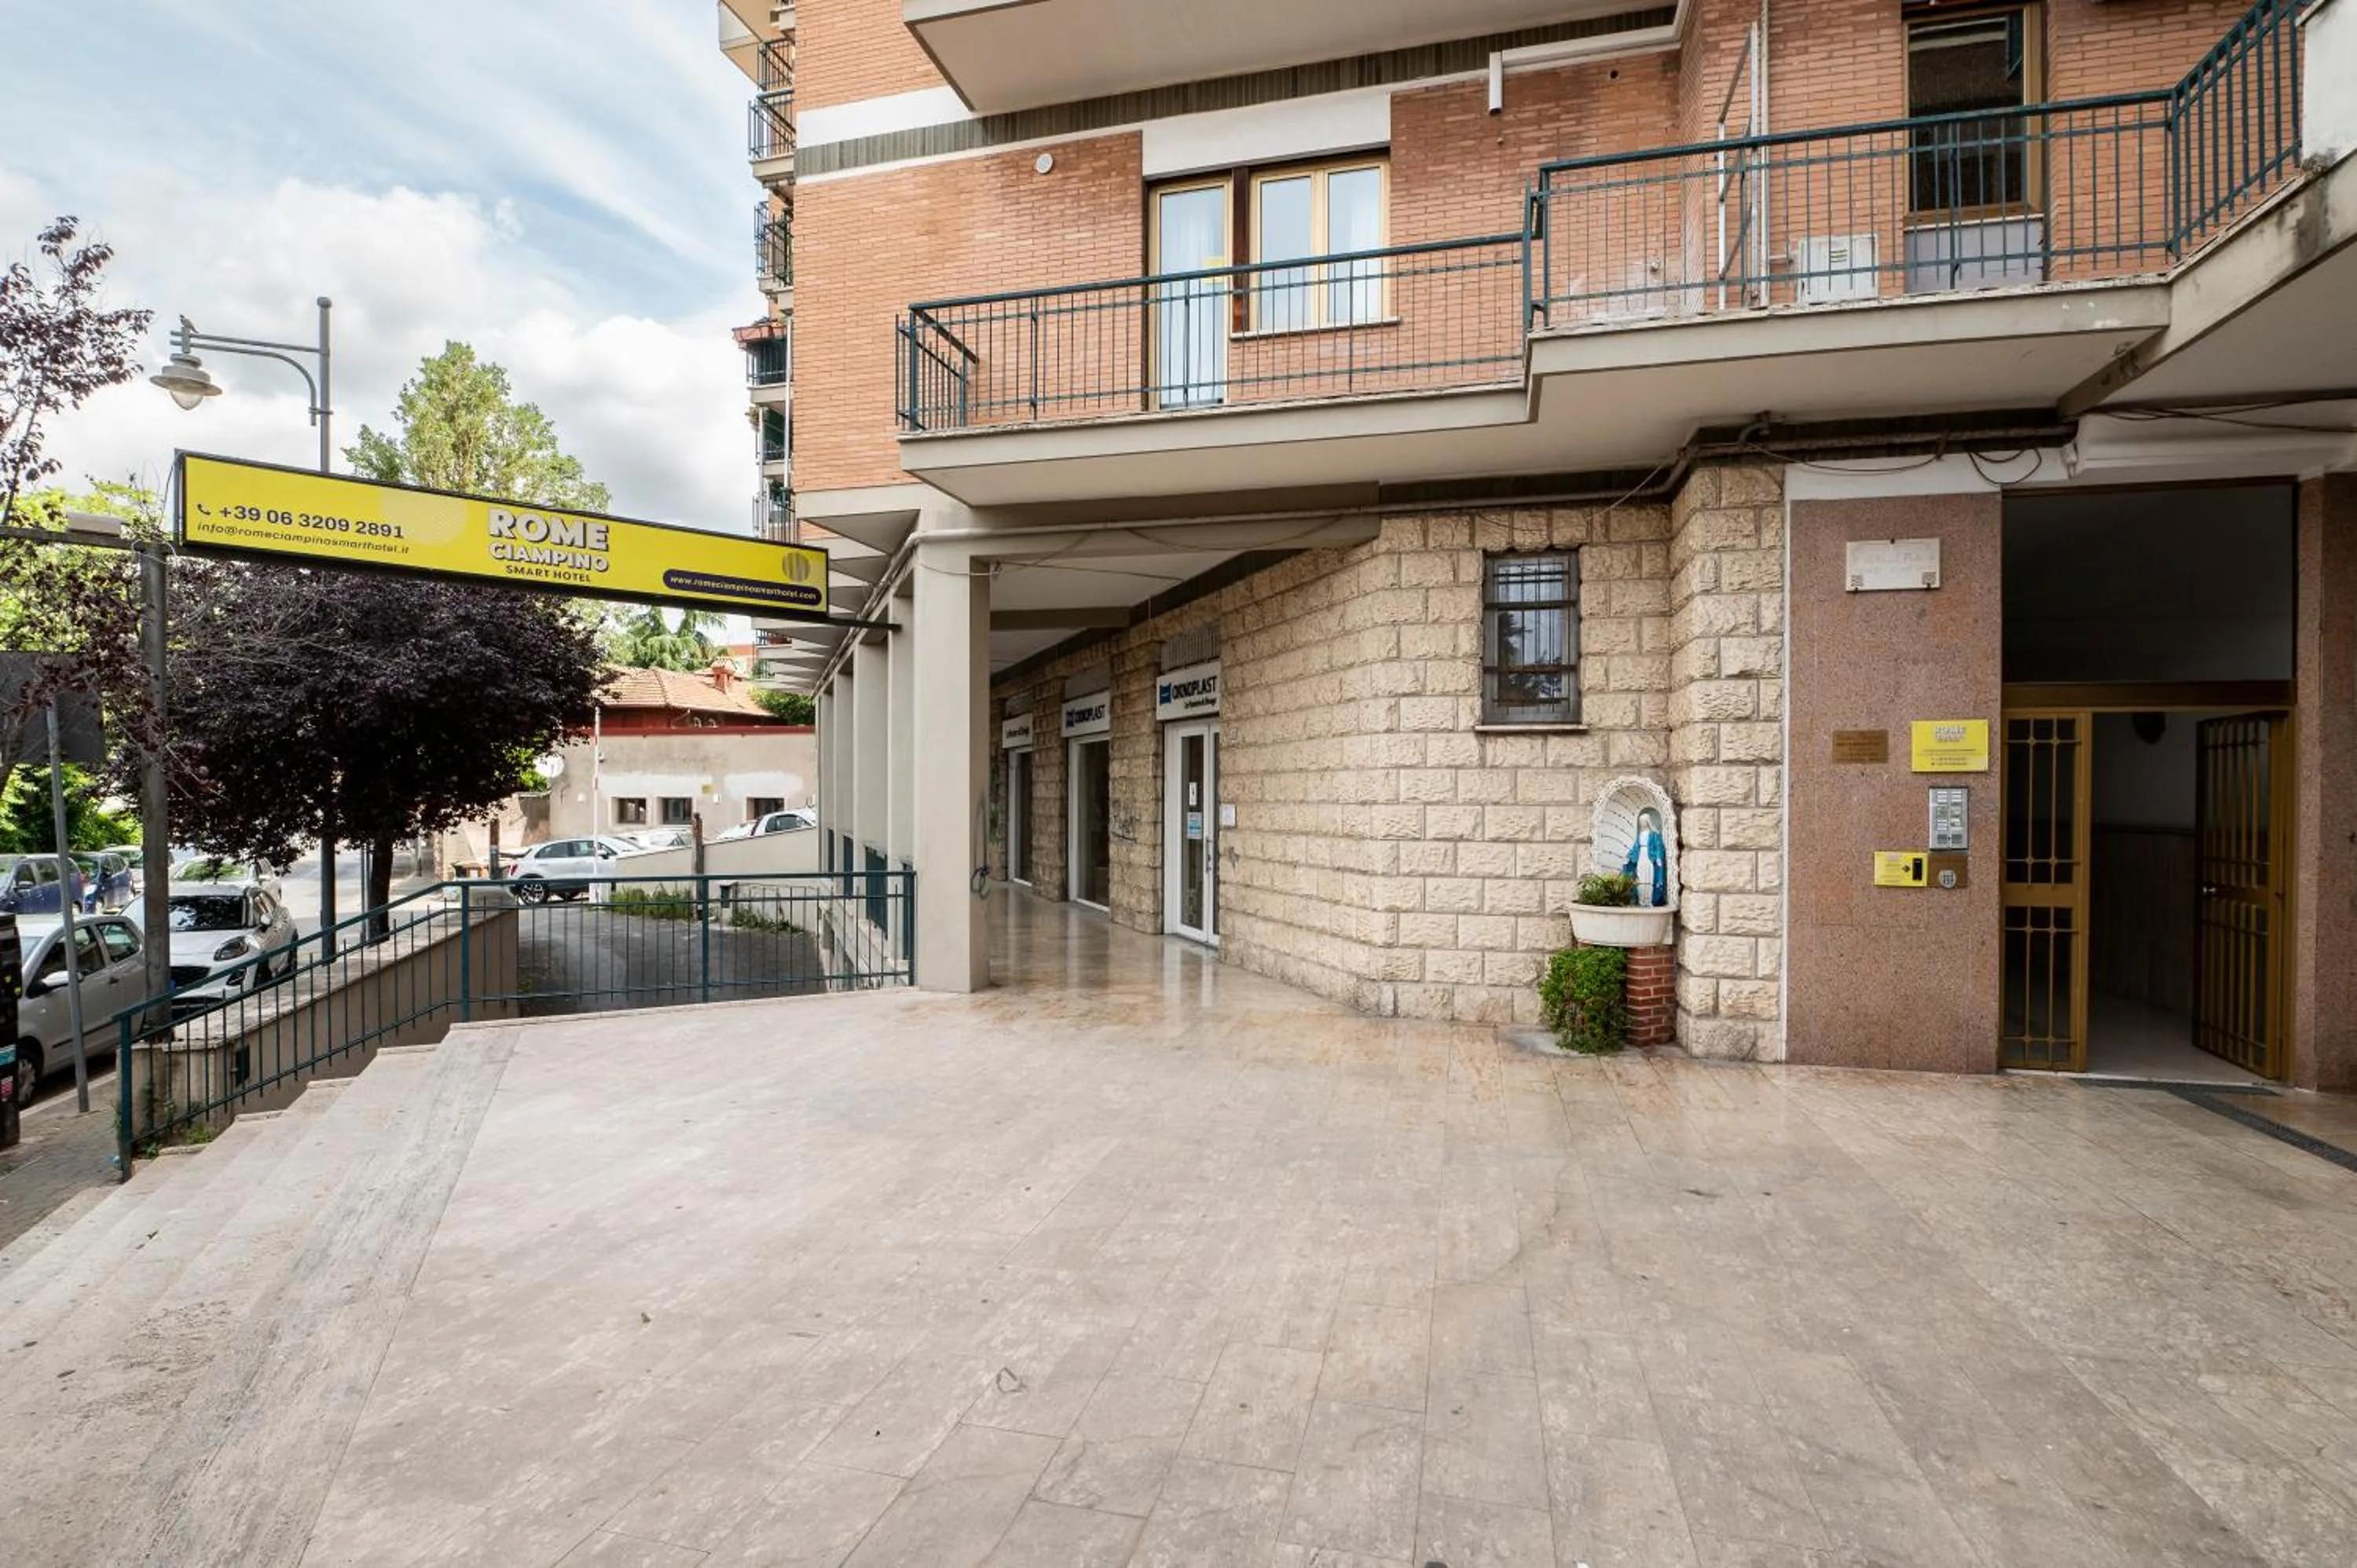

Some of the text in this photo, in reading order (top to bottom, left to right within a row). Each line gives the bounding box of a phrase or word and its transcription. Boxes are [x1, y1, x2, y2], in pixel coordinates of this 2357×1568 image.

[220, 505, 404, 540] +39 06 3209 2891
[489, 509, 609, 551] ROME
[489, 541, 609, 573] CIAMPINO
[506, 565, 591, 582] SMART HOTEL
